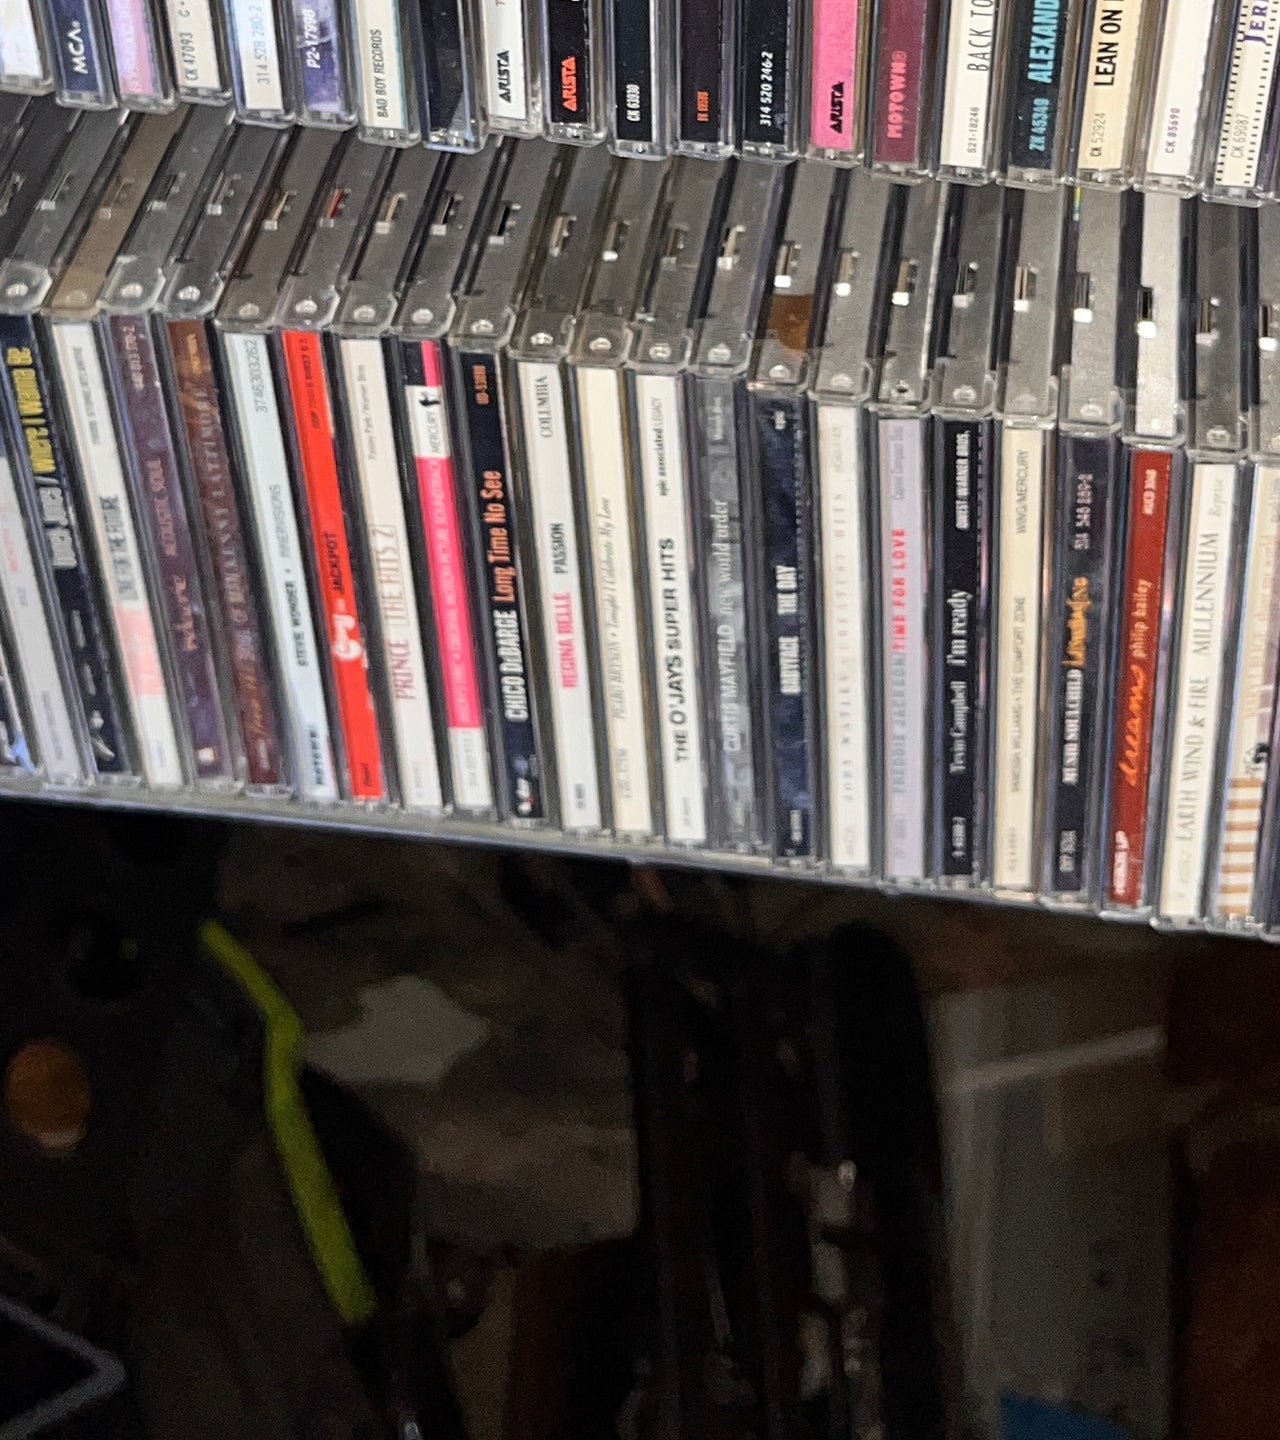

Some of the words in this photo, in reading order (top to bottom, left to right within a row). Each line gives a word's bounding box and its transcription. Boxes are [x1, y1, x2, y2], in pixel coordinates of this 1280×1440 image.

[1099, 8, 1123, 34] ON
[65, 27, 89, 73] MCA
[369, 28, 385, 74] RECORDS
[966, 26, 991, 71] BACK
[1093, 41, 1119, 87] LEAN
[374, 77, 387, 95] BOY
[497, 49, 511, 103] ARISTA
[560, 55, 578, 111] ARISTA
[376, 97, 389, 117] BAD
[829, 80, 845, 133] ARISTA
[533, 374, 554, 439] COLUMBIA
[478, 469, 505, 499] See
[481, 502, 508, 522] No
[709, 499, 730, 540] order
[324, 532, 345, 595] JACKPOT
[373, 538, 401, 586] HITS
[484, 526, 511, 562] Time
[548, 521, 569, 575] PASSION
[659, 536, 677, 581] HITS
[712, 540, 732, 584] world
[488, 564, 518, 603] Long
[775, 563, 797, 590] DAY
[1132, 576, 1152, 616] bailey
[1191, 532, 1220, 657] MILLENNIUM
[381, 587, 405, 621] THE
[552, 590, 574, 634] BELLE
[662, 586, 682, 650] SUPER
[776, 591, 798, 616] THE
[946, 587, 972, 636] ready
[1129, 619, 1149, 660] philip
[388, 638, 416, 700] PRINCE
[556, 638, 578, 688] REGINA
[665, 654, 687, 725] O'JAYS
[1186, 676, 1208, 708] FIRE
[671, 728, 690, 762] THE
[1180, 734, 1203, 782] WIND
[1176, 788, 1199, 841] EARTH
